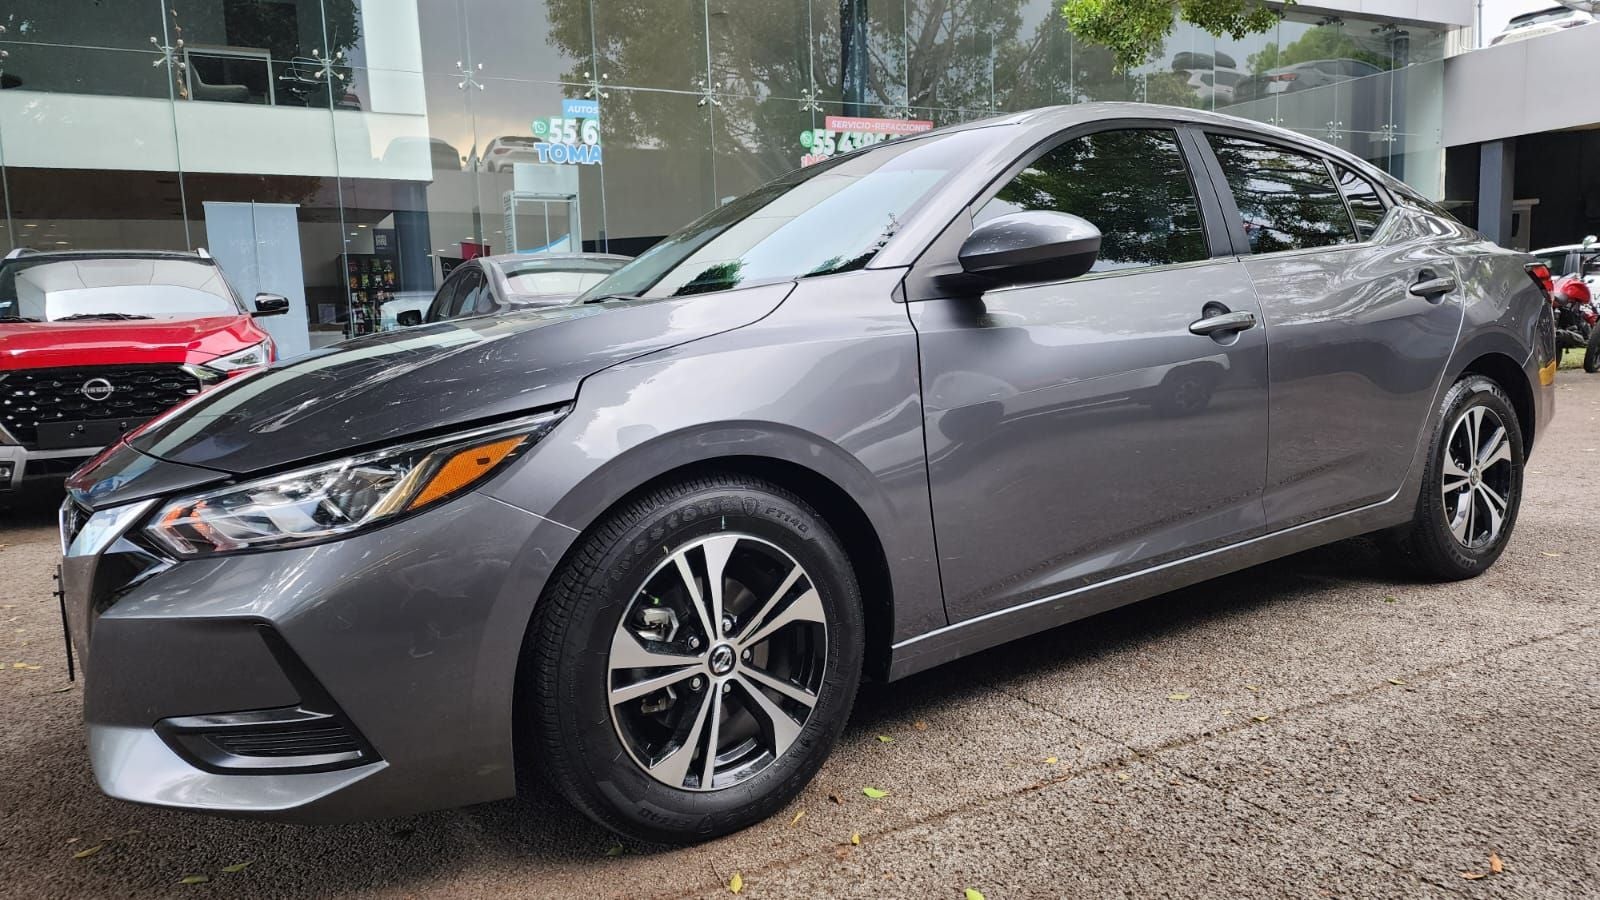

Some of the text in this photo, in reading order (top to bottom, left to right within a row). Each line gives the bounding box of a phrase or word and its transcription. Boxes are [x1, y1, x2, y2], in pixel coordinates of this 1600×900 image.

[567, 105, 599, 115] AUTOS
[549, 118, 600, 146] 55 6
[810, 128, 836, 156] 55
[533, 142, 602, 166] TOMA
